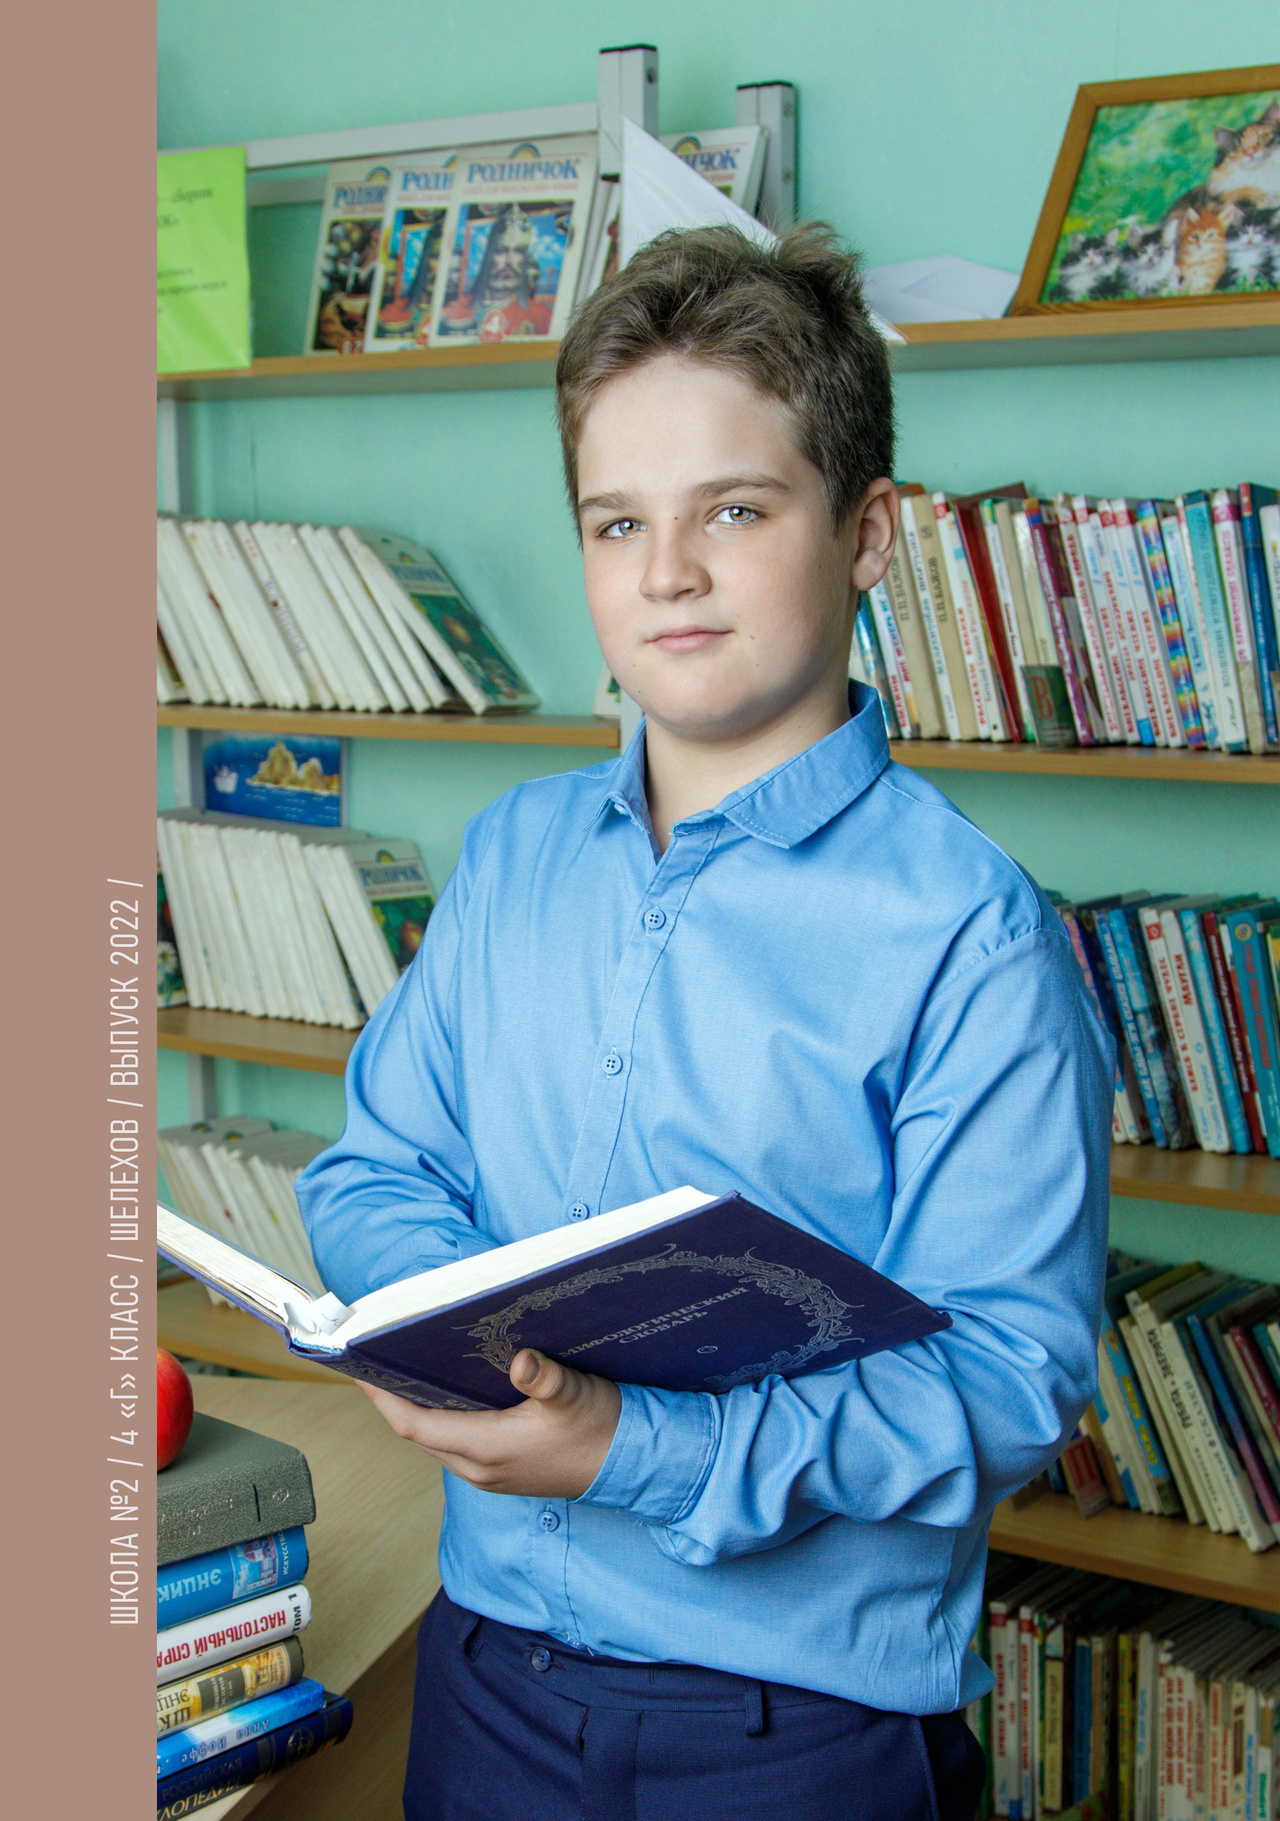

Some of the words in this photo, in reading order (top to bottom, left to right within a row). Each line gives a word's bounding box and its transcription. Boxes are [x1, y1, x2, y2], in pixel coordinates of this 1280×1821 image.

[466, 158, 579, 184] РОДНИЧОК
[558, 1286, 750, 1358] МИФОЛОГИЧЕСКИЙ
[619, 1311, 708, 1344] СЛОВАРЬ
[157, 1568, 222, 1604] ЭНЦИК
[288, 1593, 298, 1602] 1
[193, 1610, 287, 1658] НАСТОЛЬНЫЙ
[292, 1606, 301, 1633] ТОМ
[236, 1719, 270, 1740] Анна
[181, 1736, 227, 1764] Иоффе
[161, 1757, 243, 1799] РОССИЙСКАЯ
[157, 1775, 241, 1821] ЛОПЕДИЯ
